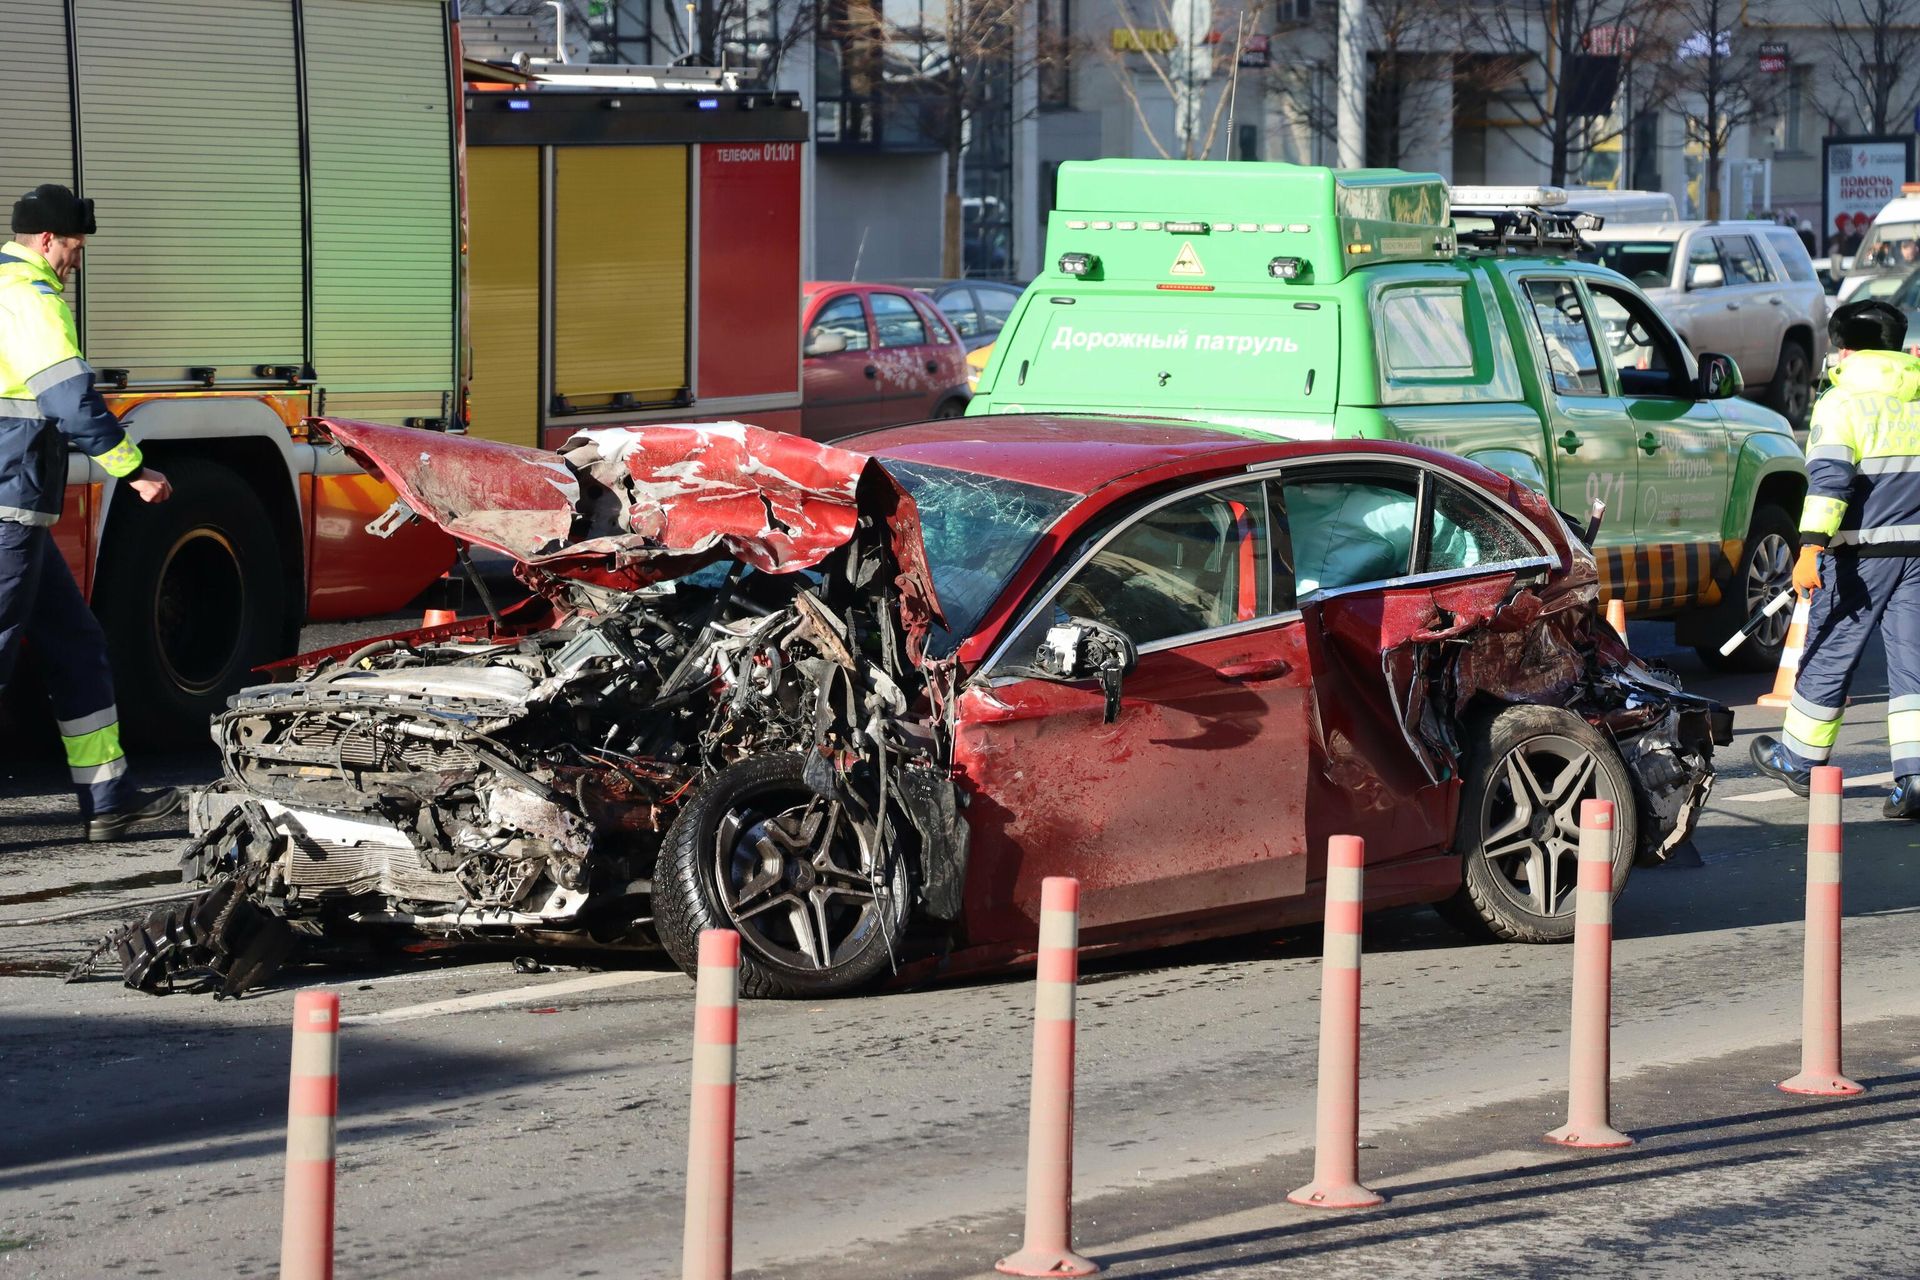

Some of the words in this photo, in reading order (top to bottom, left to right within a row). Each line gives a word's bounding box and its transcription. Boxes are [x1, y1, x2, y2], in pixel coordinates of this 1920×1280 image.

[717, 148, 761, 162] ТЕЛЕФОН
[763, 143, 796, 161] 01.101
[1840, 175, 1893, 187] ПОМОЧЬ
[1840, 187, 1893, 199] ПРОСТО!
[1051, 326, 1189, 351] Дорожный
[1195, 333, 1299, 356] патруль
[1667, 457, 1713, 483] патруль
[1584, 471, 1625, 523] 971
